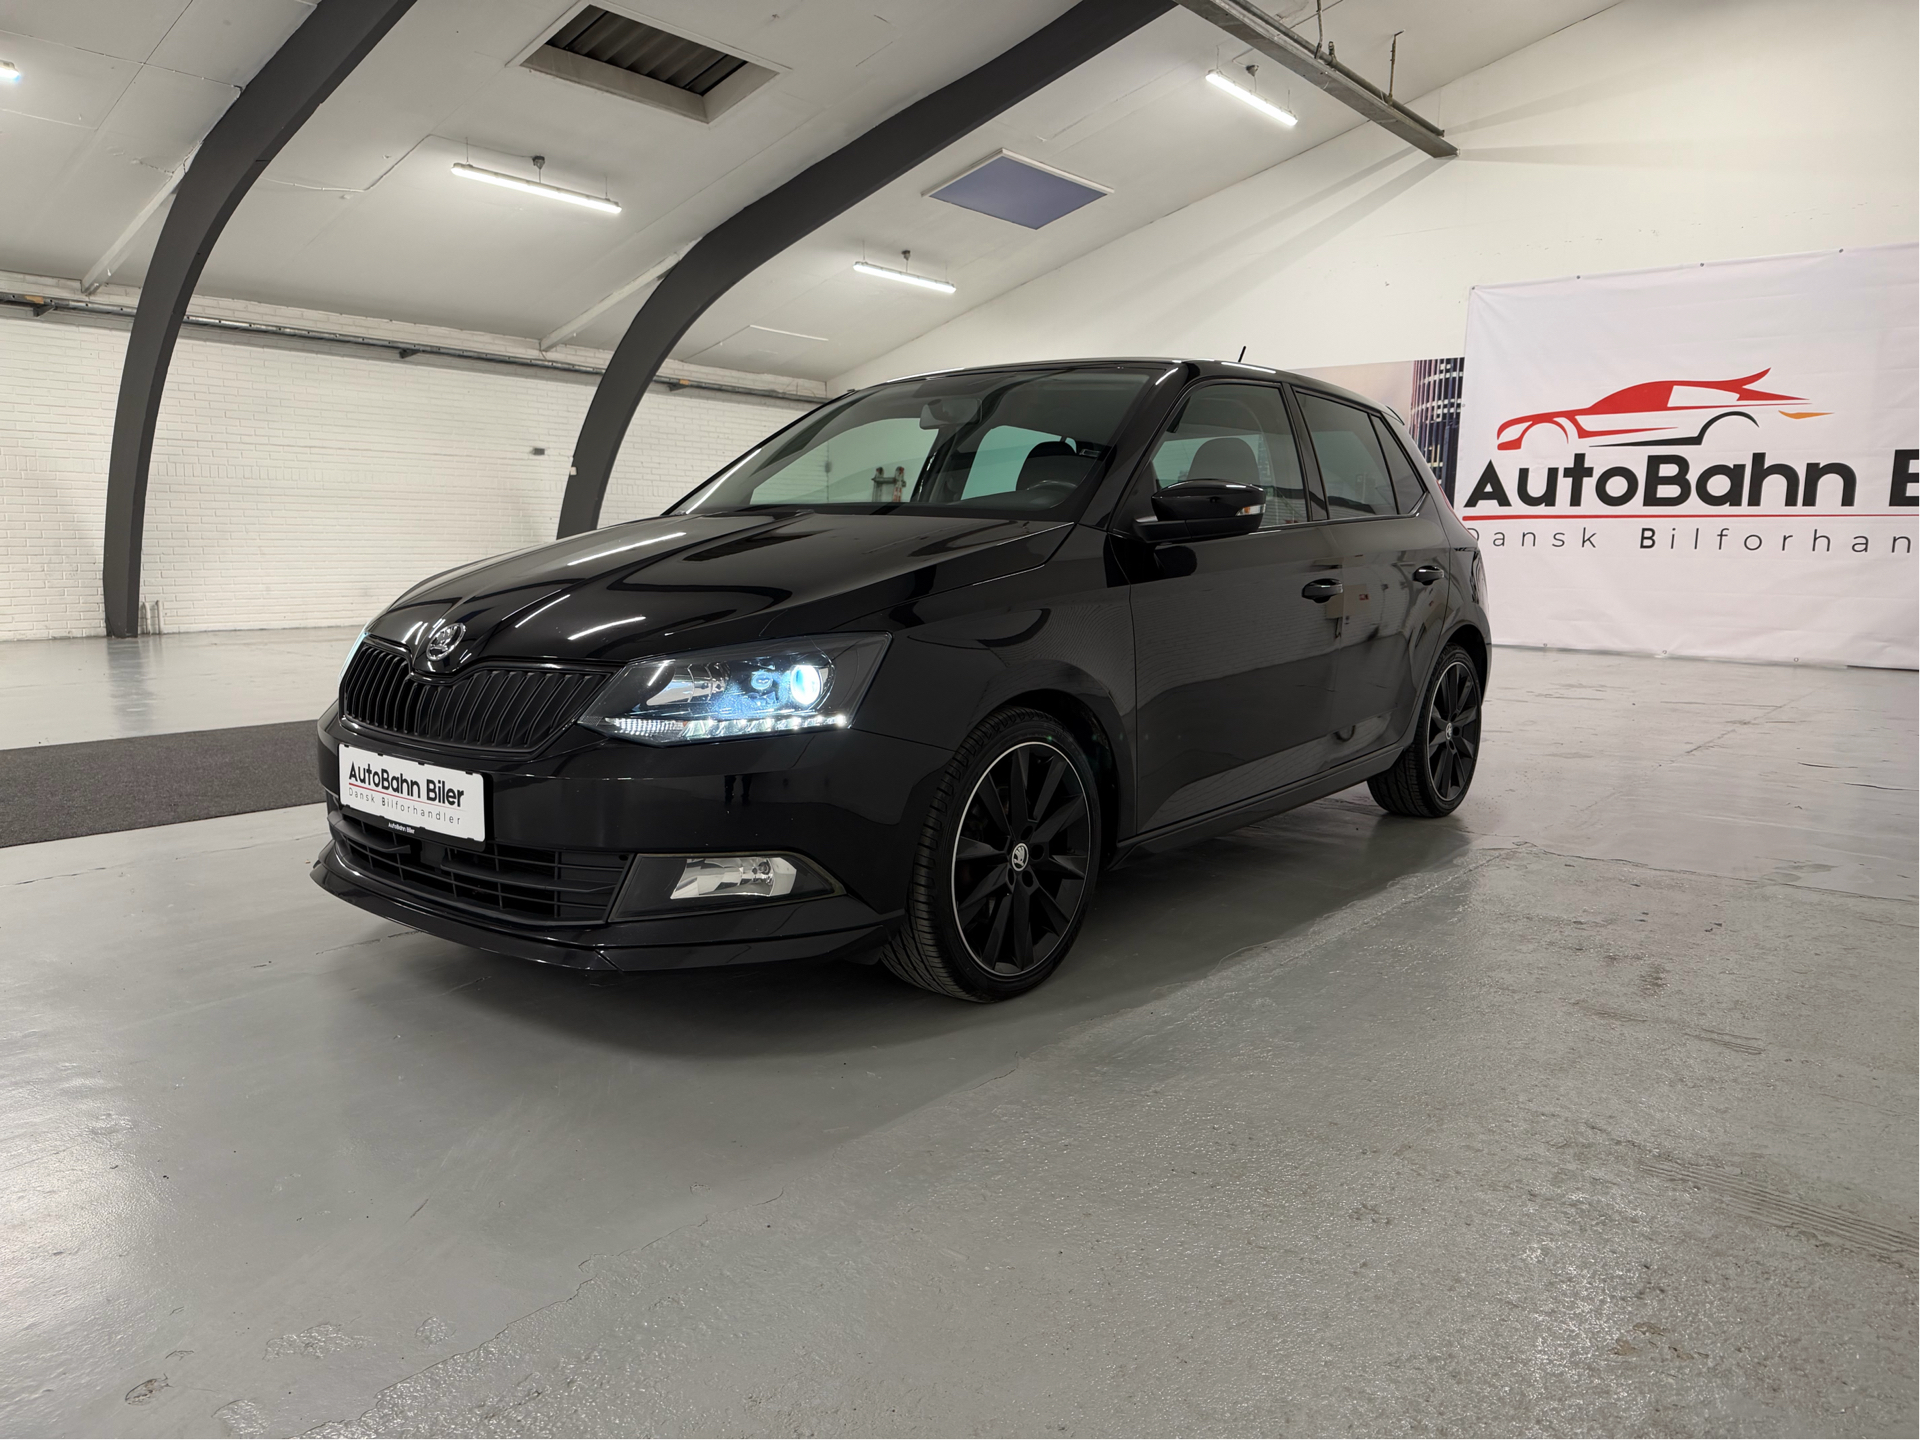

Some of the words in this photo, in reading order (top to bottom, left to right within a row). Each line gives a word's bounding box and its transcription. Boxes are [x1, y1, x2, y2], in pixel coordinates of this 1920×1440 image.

[1463, 451, 1858, 508] AutoBahn
[1639, 527, 1912, 554] Bilforhan
[348, 761, 421, 799] AutoBahn
[426, 778, 465, 808] Biler
[348, 787, 376, 804] Dansk
[381, 796, 462, 825] Bilforhandler
